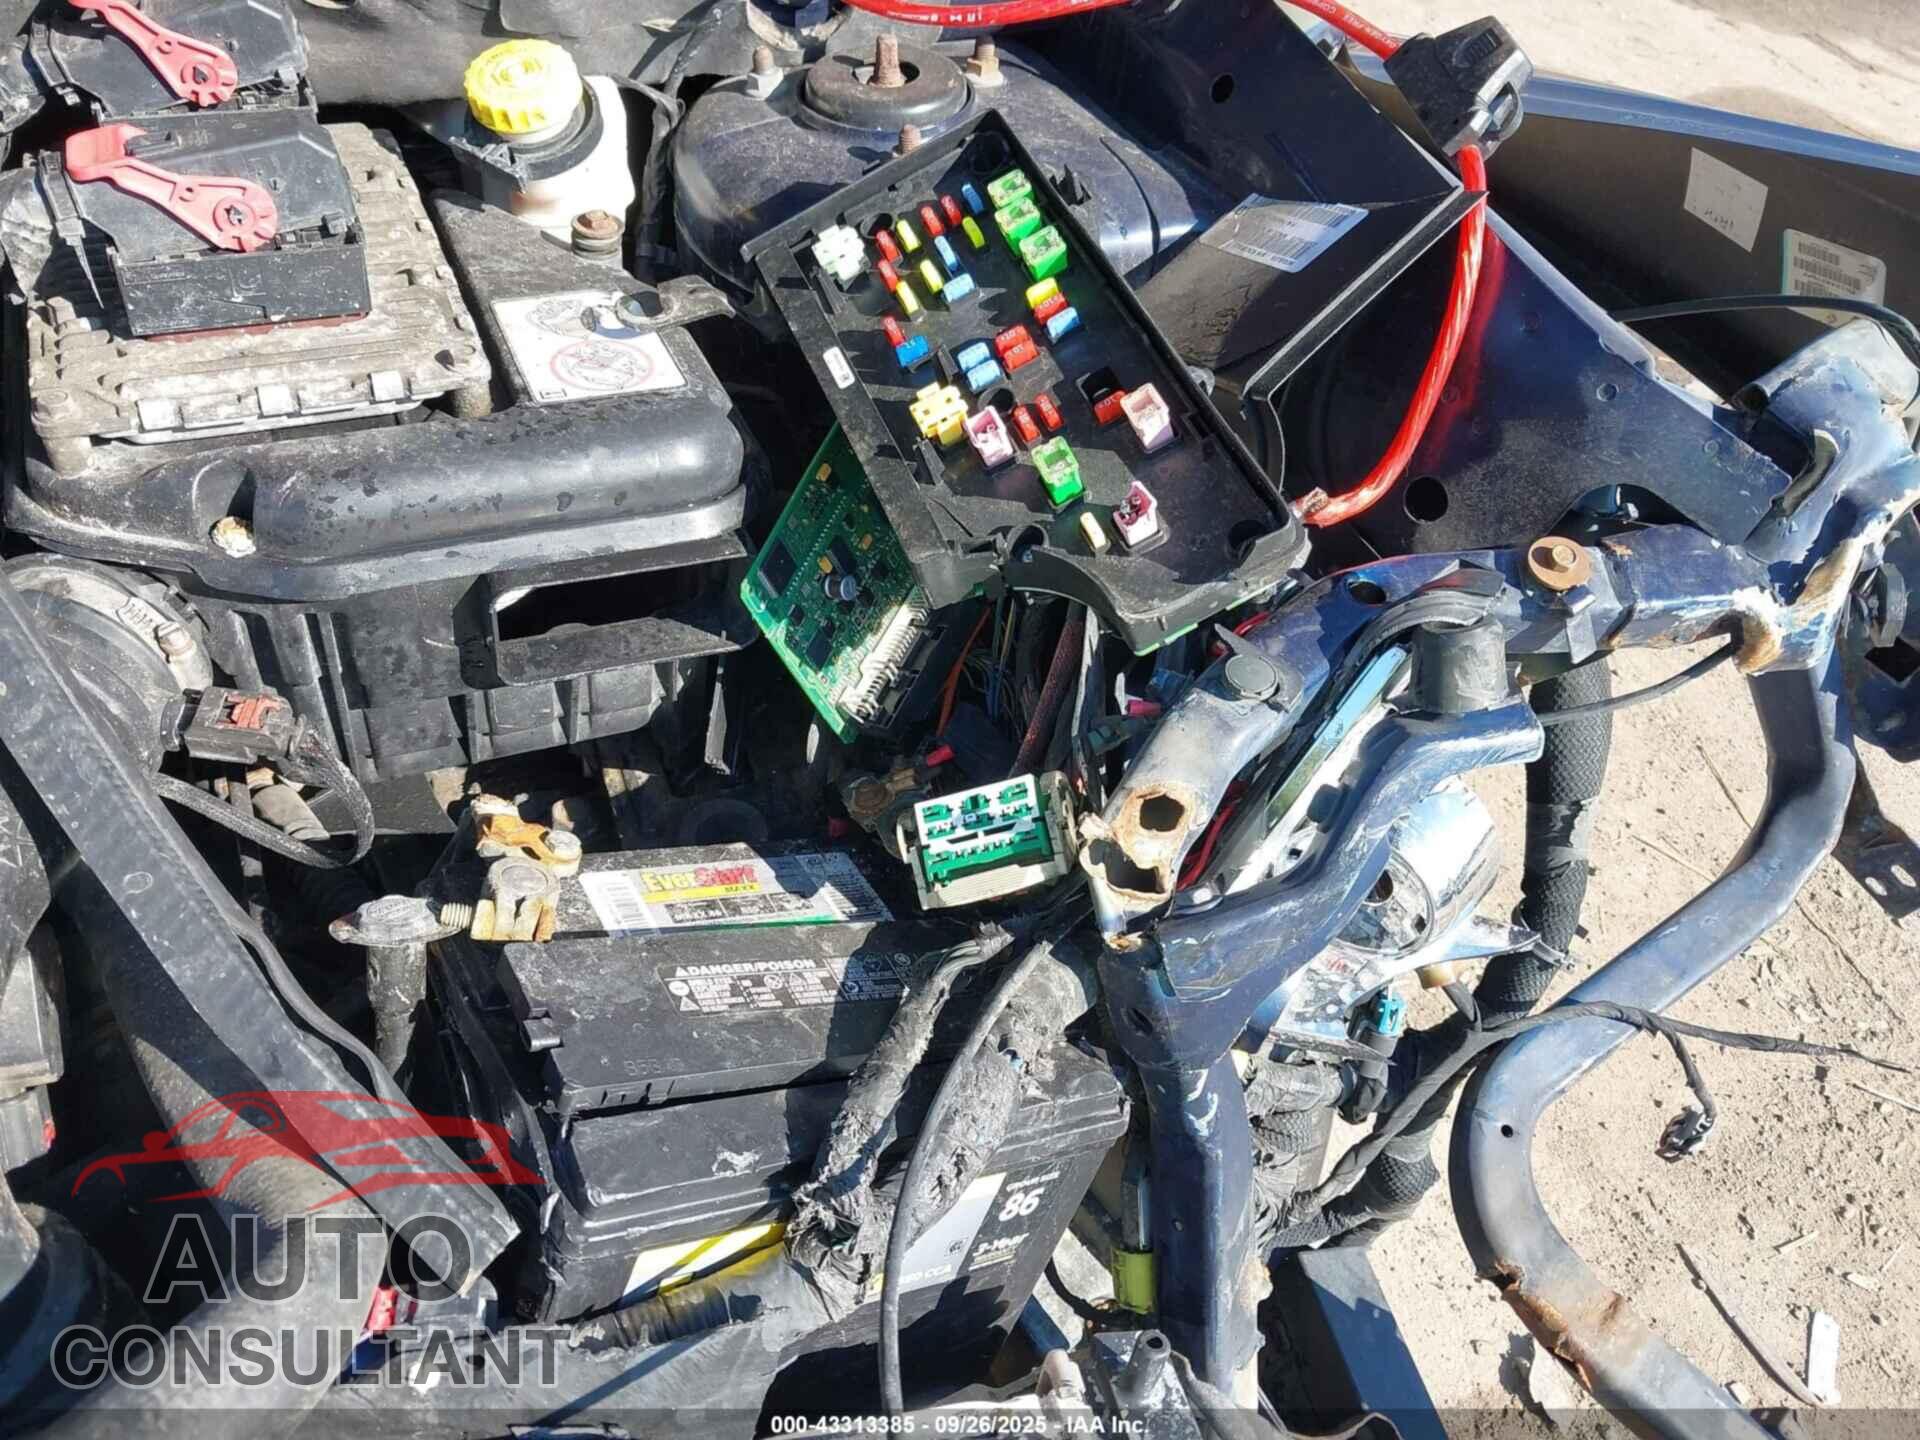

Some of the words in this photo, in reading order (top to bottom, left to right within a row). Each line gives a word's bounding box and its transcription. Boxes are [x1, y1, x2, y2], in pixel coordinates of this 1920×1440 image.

[640, 866, 757, 893] EverStart
[686, 958, 816, 976] DANGER/POISON
[998, 1188, 1044, 1222] 86
